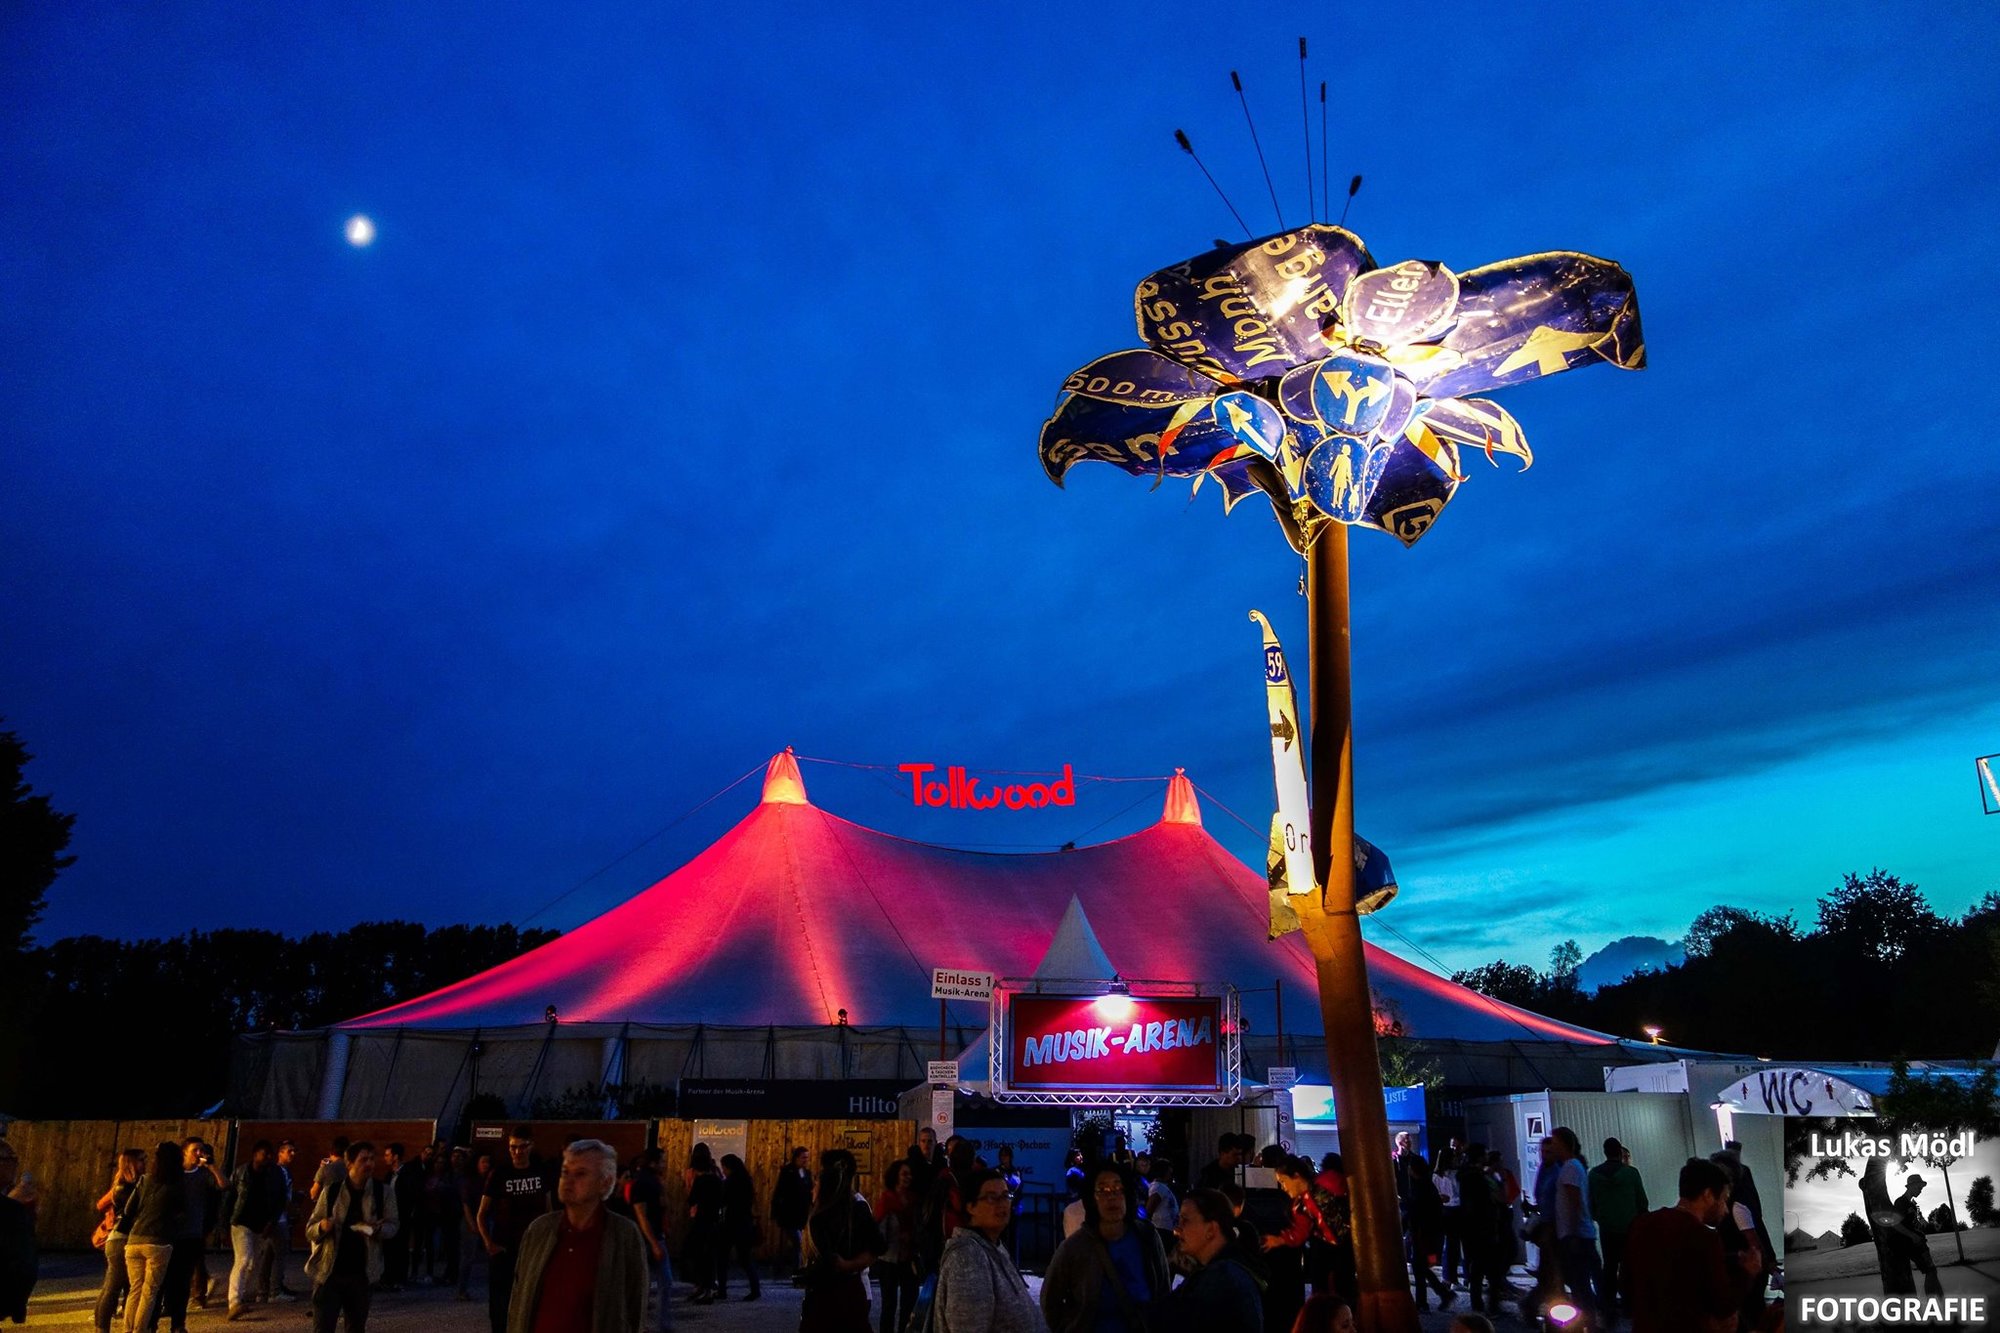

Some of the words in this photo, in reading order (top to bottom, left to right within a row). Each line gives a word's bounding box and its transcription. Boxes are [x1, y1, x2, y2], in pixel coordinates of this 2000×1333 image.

[1365, 268, 1424, 325] Eller
[1198, 274, 1289, 367] Monh
[1065, 373, 1136, 394] 500
[1267, 652, 1282, 677] 59
[898, 763, 1075, 810] Tollwood
[935, 972, 981, 986] Einlass
[985, 976, 991, 987] 1
[935, 986, 990, 998] Musik-Arena
[1023, 1016, 1212, 1066] MUSIK-ARENA
[688, 1088, 712, 1096] Partner
[725, 1088, 765, 1096] Musik-Arena
[1759, 1071, 1812, 1115] WC
[849, 1095, 897, 1113] Hilto
[505, 1176, 542, 1192] STATE
